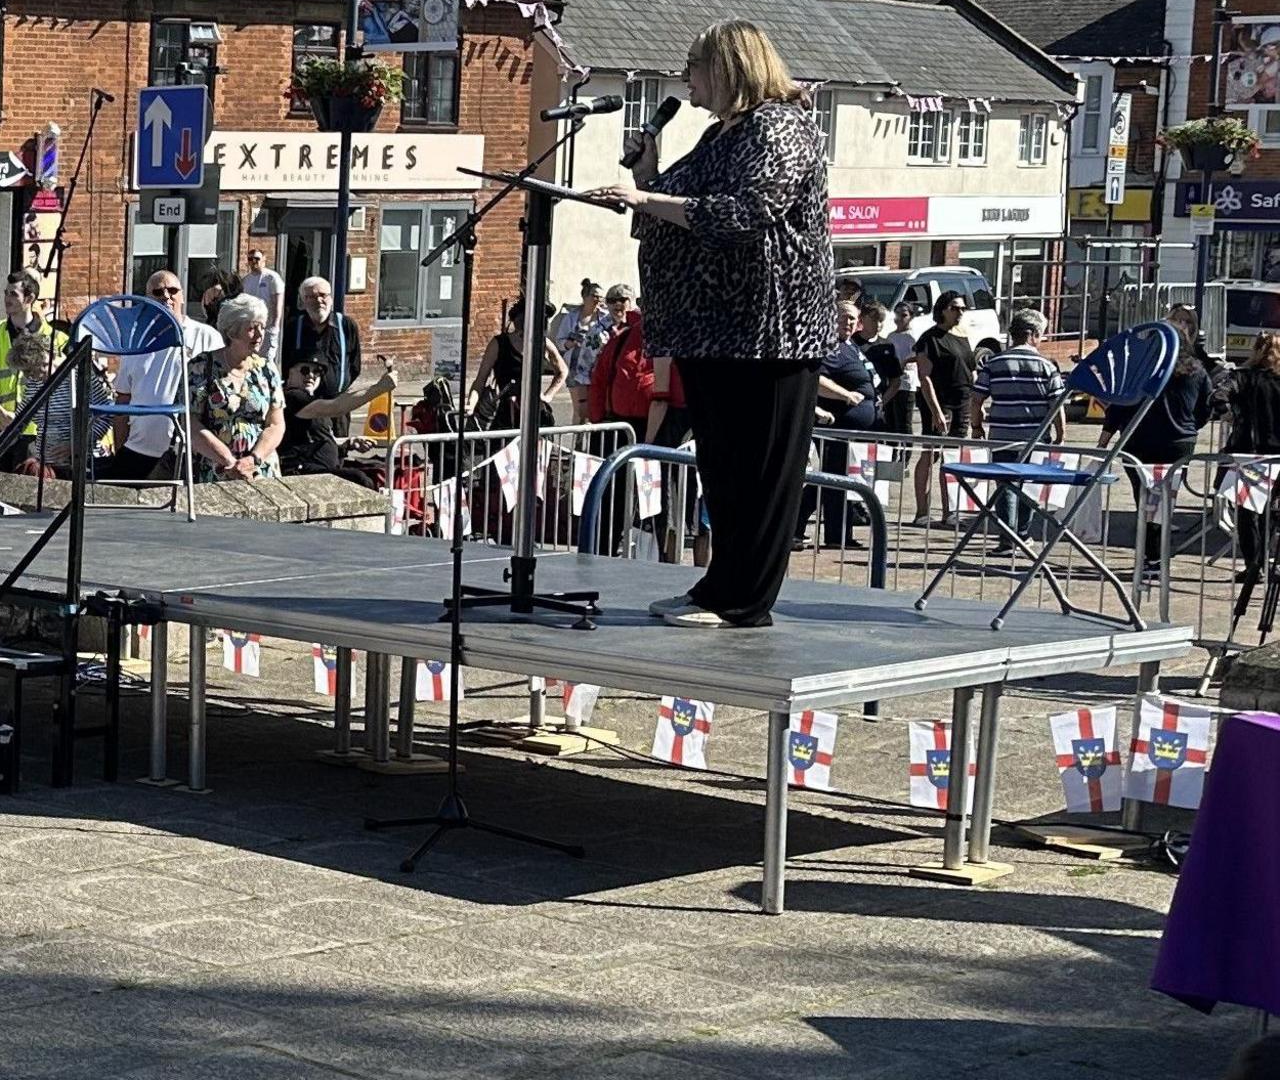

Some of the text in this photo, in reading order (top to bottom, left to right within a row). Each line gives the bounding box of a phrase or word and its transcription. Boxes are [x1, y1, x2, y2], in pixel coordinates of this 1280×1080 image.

[214, 143, 418, 170] EXTREMES
[241, 173, 269, 182] HAIR
[282, 173, 326, 182] BEAUTY
[159, 203, 181, 216] End
[829, 205, 880, 220] AIL SALON
